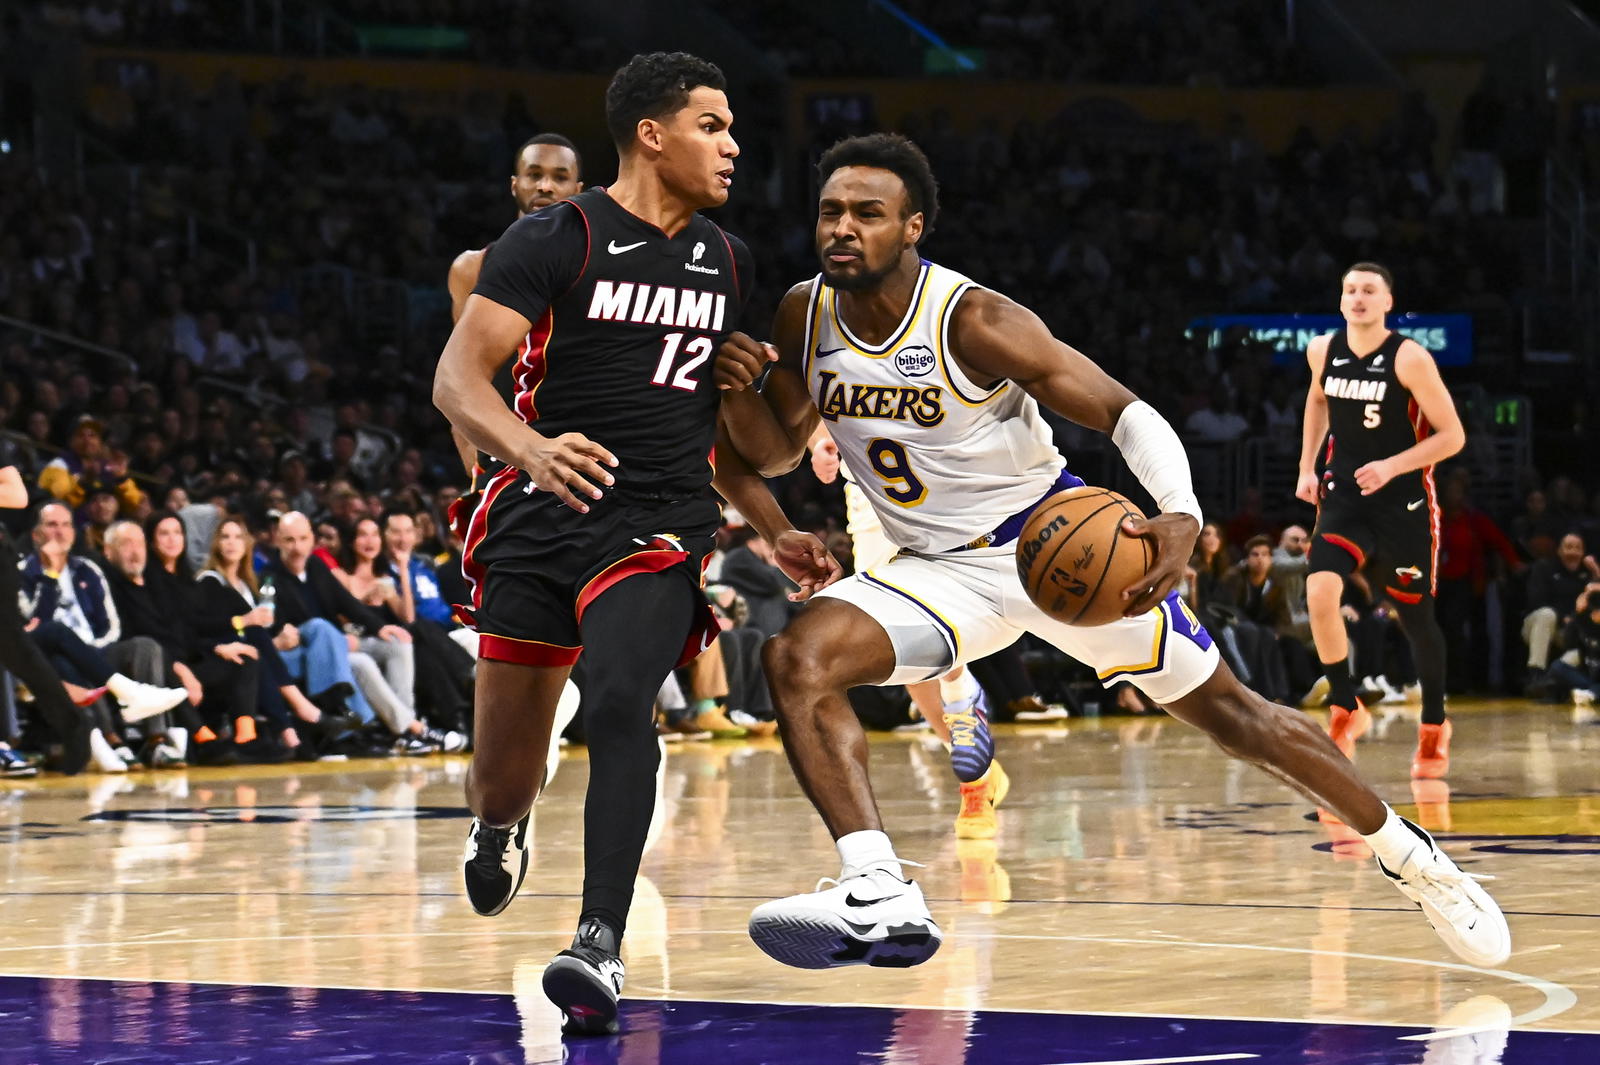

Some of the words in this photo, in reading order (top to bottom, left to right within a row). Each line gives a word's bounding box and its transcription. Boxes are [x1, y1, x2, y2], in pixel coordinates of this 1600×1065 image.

[684, 262, 719, 275] Robinhood
[586, 279, 727, 333] MIAMI
[650, 331, 714, 392] 12
[898, 353, 933, 368] bibigo
[817, 369, 947, 429] LAKERS
[1324, 375, 1387, 402] MIAMI
[1363, 403, 1382, 429] 5
[866, 436, 929, 509] 9
